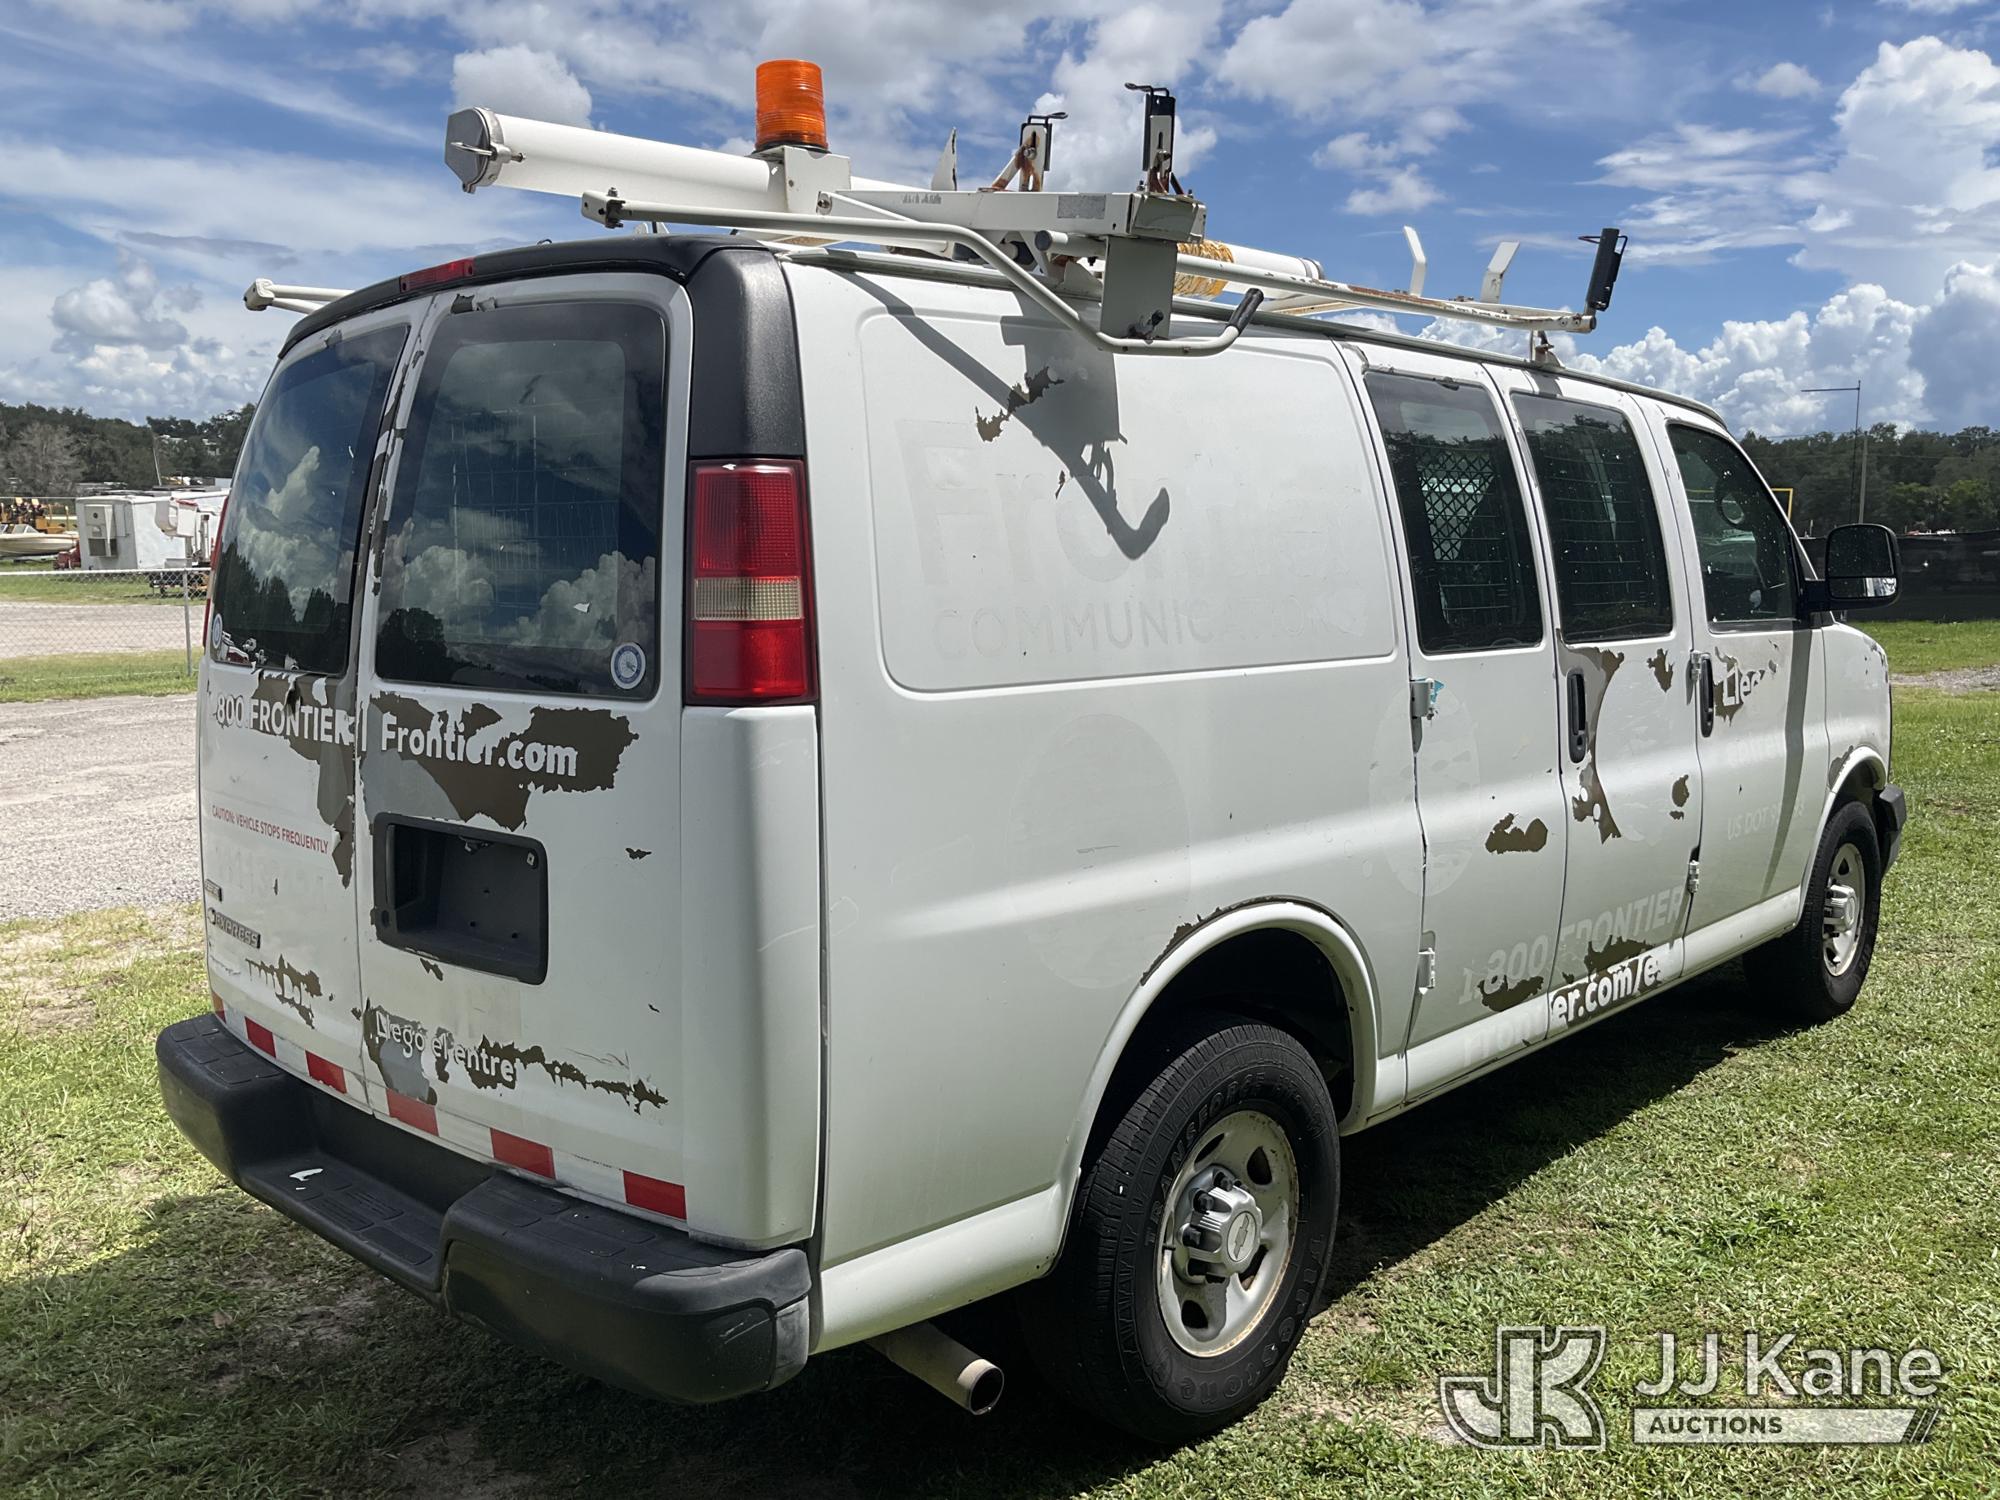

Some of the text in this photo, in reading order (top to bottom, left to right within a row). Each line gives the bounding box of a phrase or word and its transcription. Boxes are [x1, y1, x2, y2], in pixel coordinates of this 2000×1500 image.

[381, 711, 578, 777] Frontier.com
[212, 804, 329, 855] CAUTION: VEHICLE STOPS FREQUENTLY
[215, 912, 259, 948] EXPRESS
[431, 1032, 448, 1060] el
